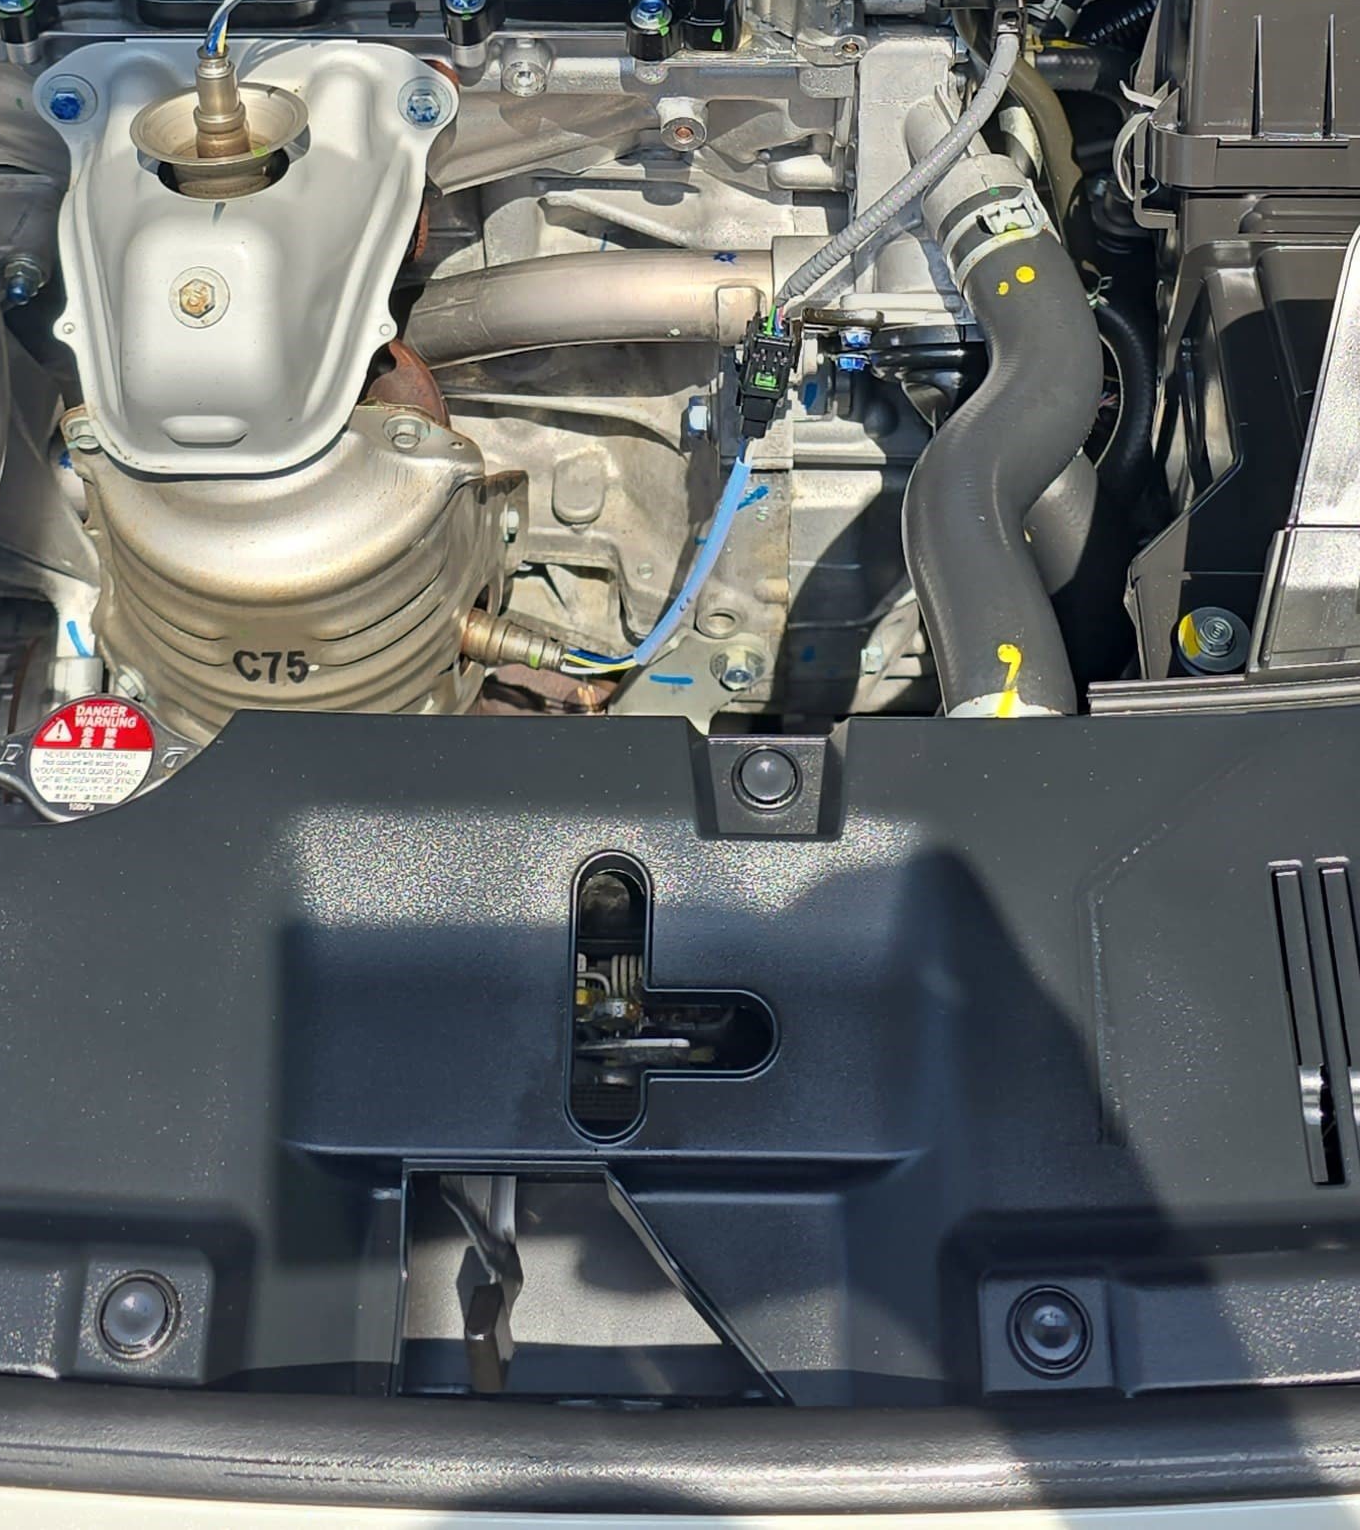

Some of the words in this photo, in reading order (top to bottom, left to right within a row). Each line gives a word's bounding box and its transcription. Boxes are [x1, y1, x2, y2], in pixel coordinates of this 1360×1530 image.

[232, 649, 309, 684] C75
[75, 703, 129, 718] DANGER
[74, 715, 138, 729] WARNUNG
